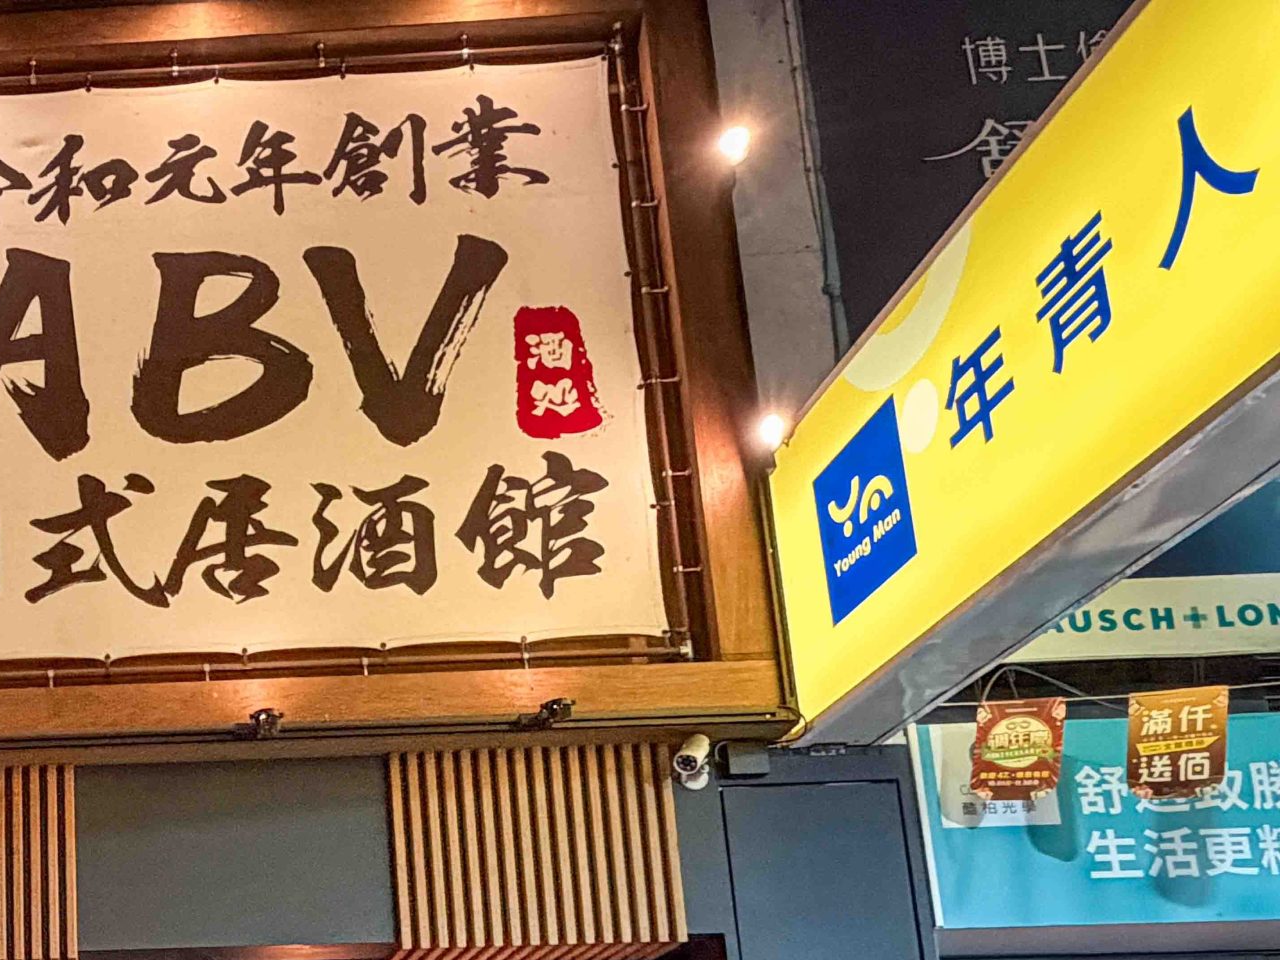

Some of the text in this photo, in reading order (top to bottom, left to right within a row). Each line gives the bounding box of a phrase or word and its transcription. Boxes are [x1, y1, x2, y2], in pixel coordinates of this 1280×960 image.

[946, 104, 1261, 449] 年青人
[834, 508, 901, 577] Young Man
